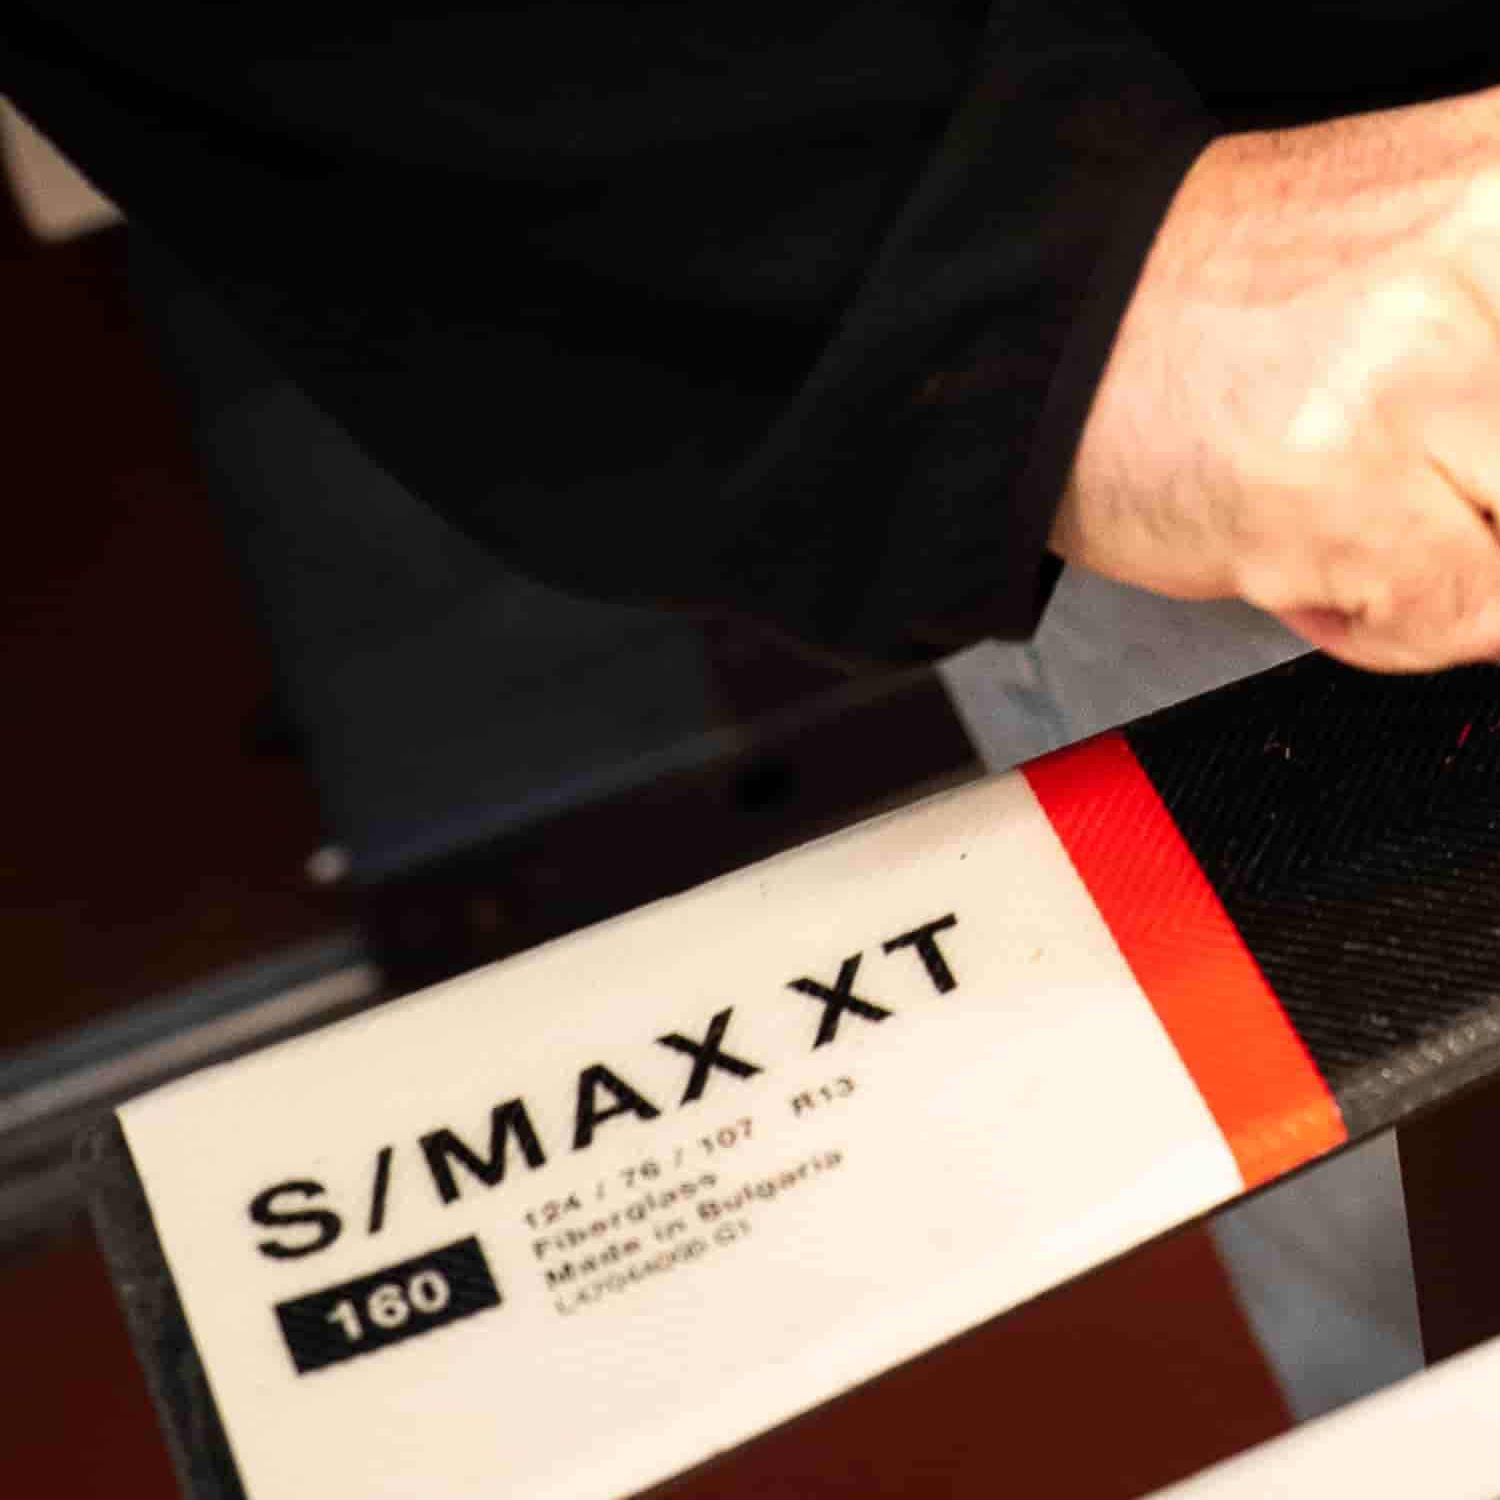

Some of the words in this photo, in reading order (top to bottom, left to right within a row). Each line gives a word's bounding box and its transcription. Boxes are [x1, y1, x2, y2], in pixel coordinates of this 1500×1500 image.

[248, 1006, 763, 1261] S/MAX
[786, 912, 958, 1050] XT
[526, 1192, 581, 1230] 124
[622, 1161, 660, 1188] 76
[700, 1117, 753, 1153] 107
[791, 1075, 855, 1117] R13
[533, 1174, 717, 1260] Fiberglass
[545, 1239, 640, 1289] Made
[654, 1220, 686, 1241] in
[698, 1151, 842, 1221] Bulgaria
[326, 1271, 449, 1342] 160
